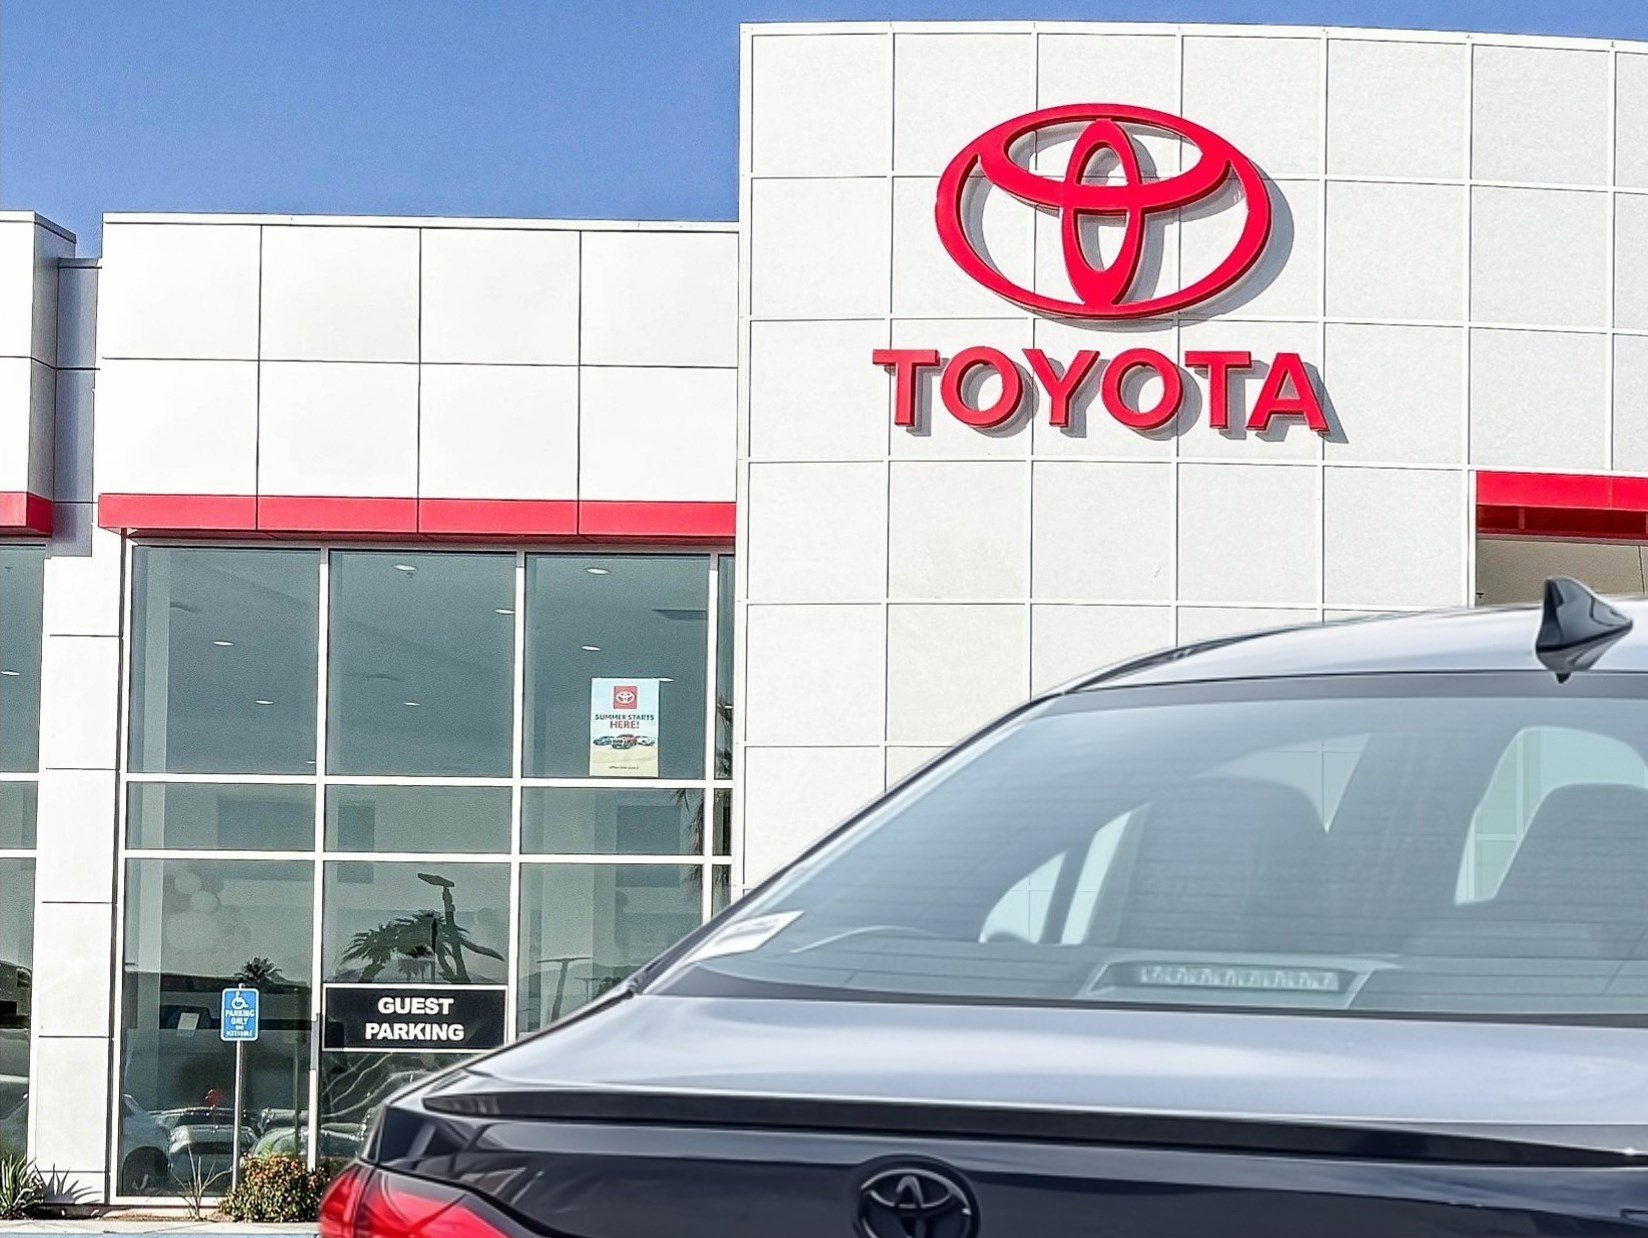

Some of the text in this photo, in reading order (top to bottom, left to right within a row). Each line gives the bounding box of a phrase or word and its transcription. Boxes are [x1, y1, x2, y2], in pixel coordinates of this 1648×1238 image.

[872, 346, 1330, 432] TOYOTA
[609, 720, 640, 729] HERE!
[377, 997, 454, 1015] GUEST
[365, 1022, 464, 1041] PARKING
